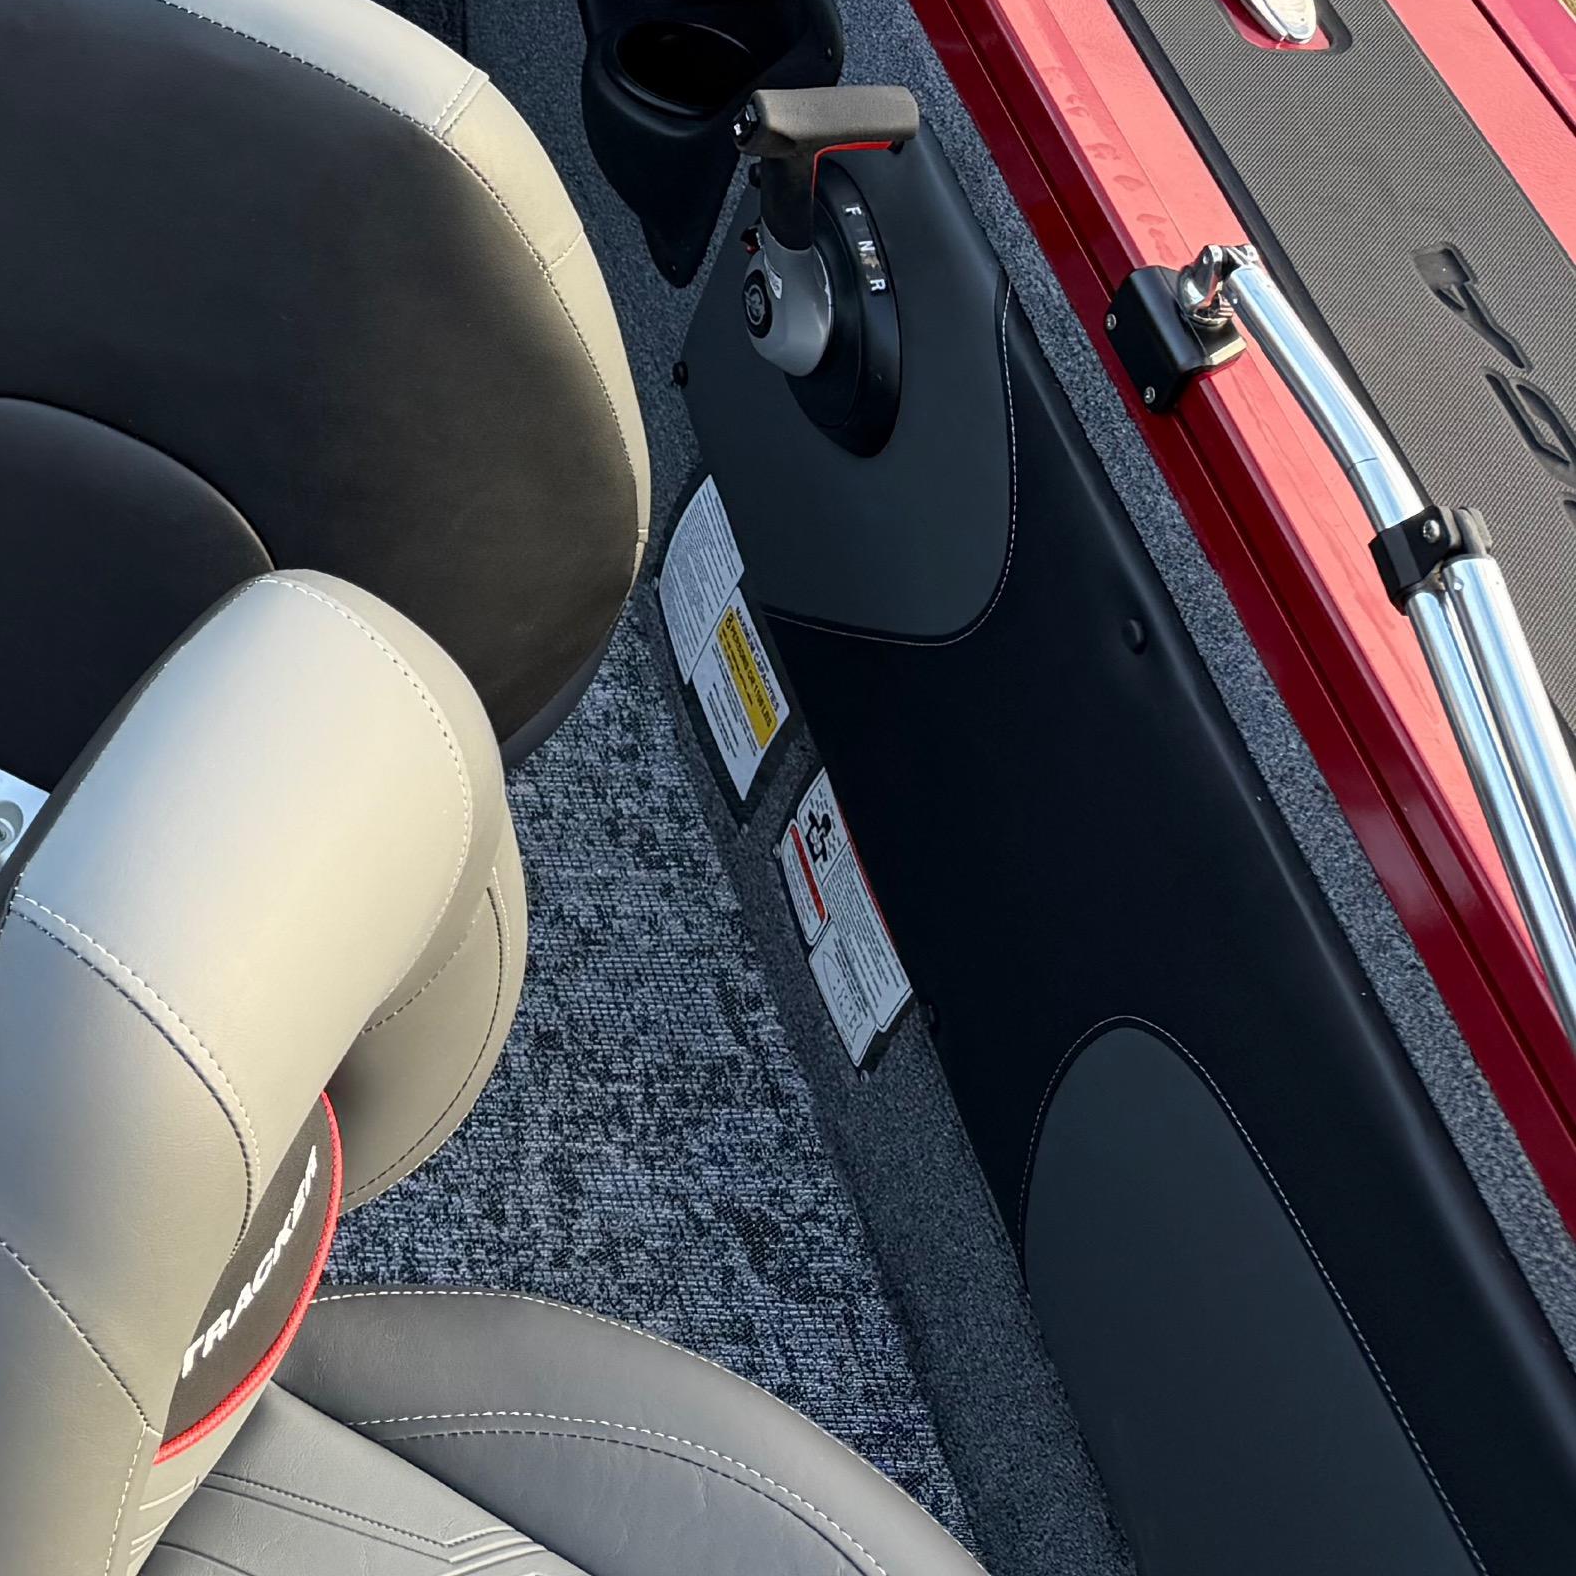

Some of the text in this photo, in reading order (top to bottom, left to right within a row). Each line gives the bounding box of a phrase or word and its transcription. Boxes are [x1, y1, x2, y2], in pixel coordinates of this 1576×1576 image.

[845, 206, 862, 217] F
[857, 240, 875, 252] N
[869, 278, 887, 292] R
[181, 1144, 318, 1380] TRACKER
